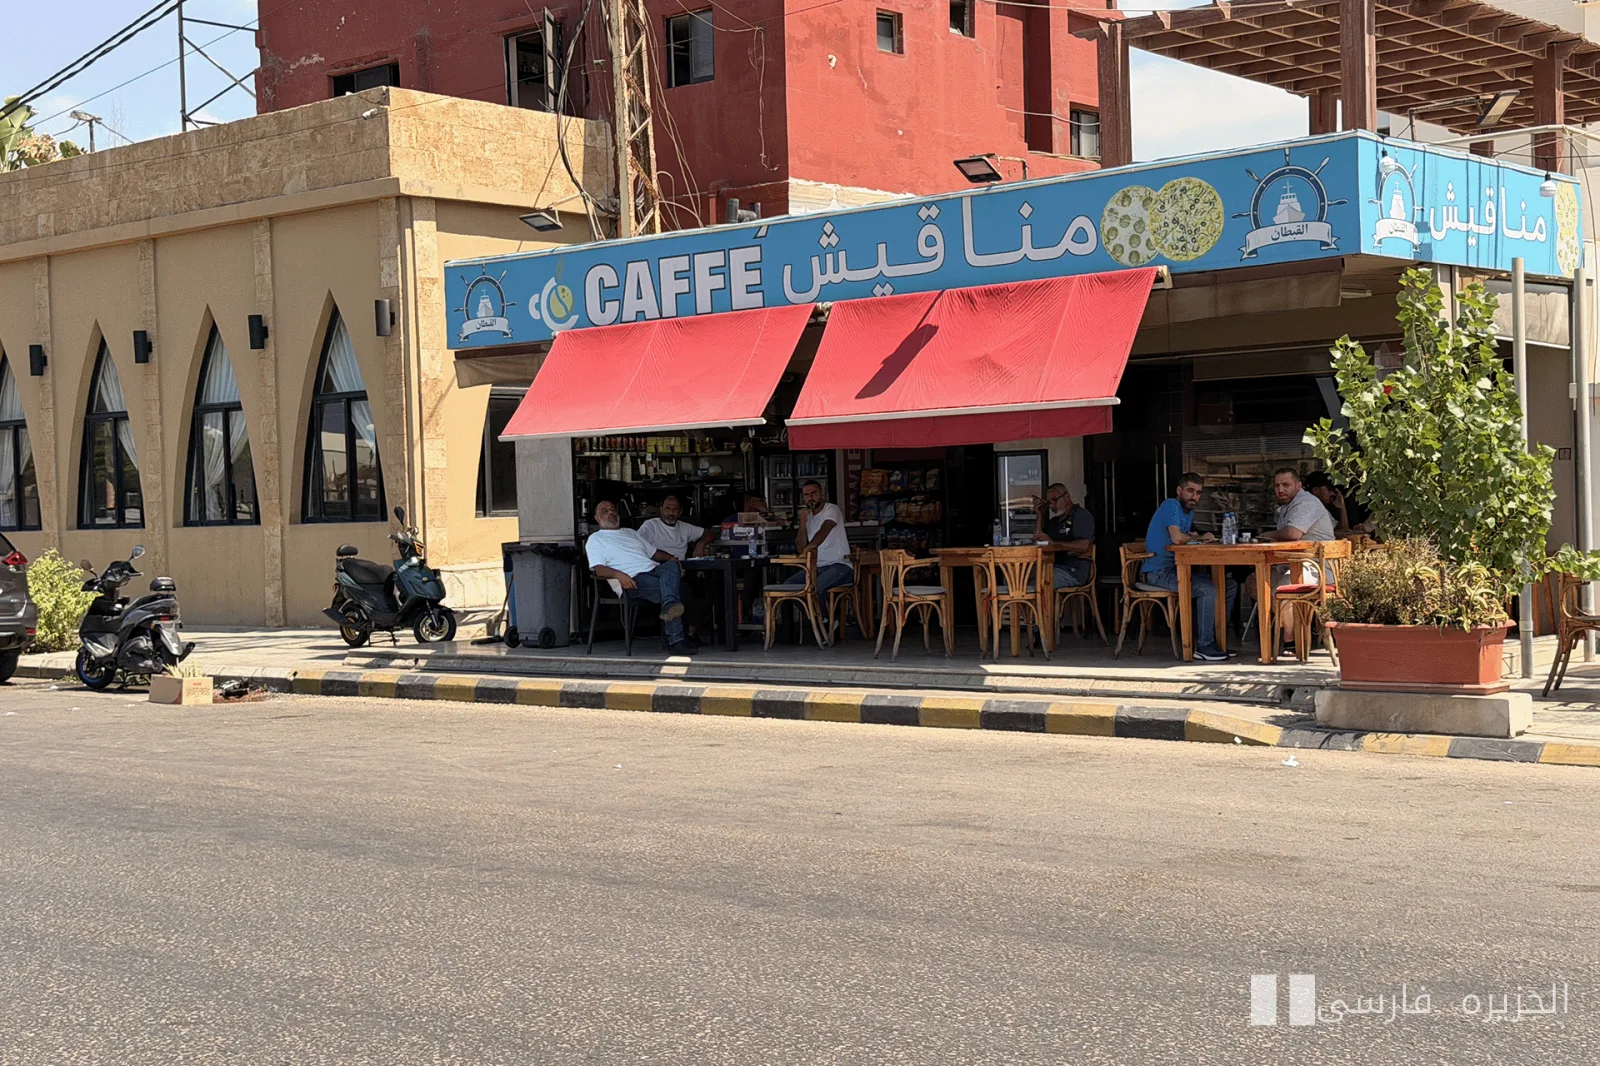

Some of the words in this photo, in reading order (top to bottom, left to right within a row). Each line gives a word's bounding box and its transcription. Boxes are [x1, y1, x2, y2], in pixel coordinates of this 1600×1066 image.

[1271, 223, 1308, 241] القبطان
[1429, 181, 1548, 247] مناقيش
[782, 196, 1099, 304] مناقيش
